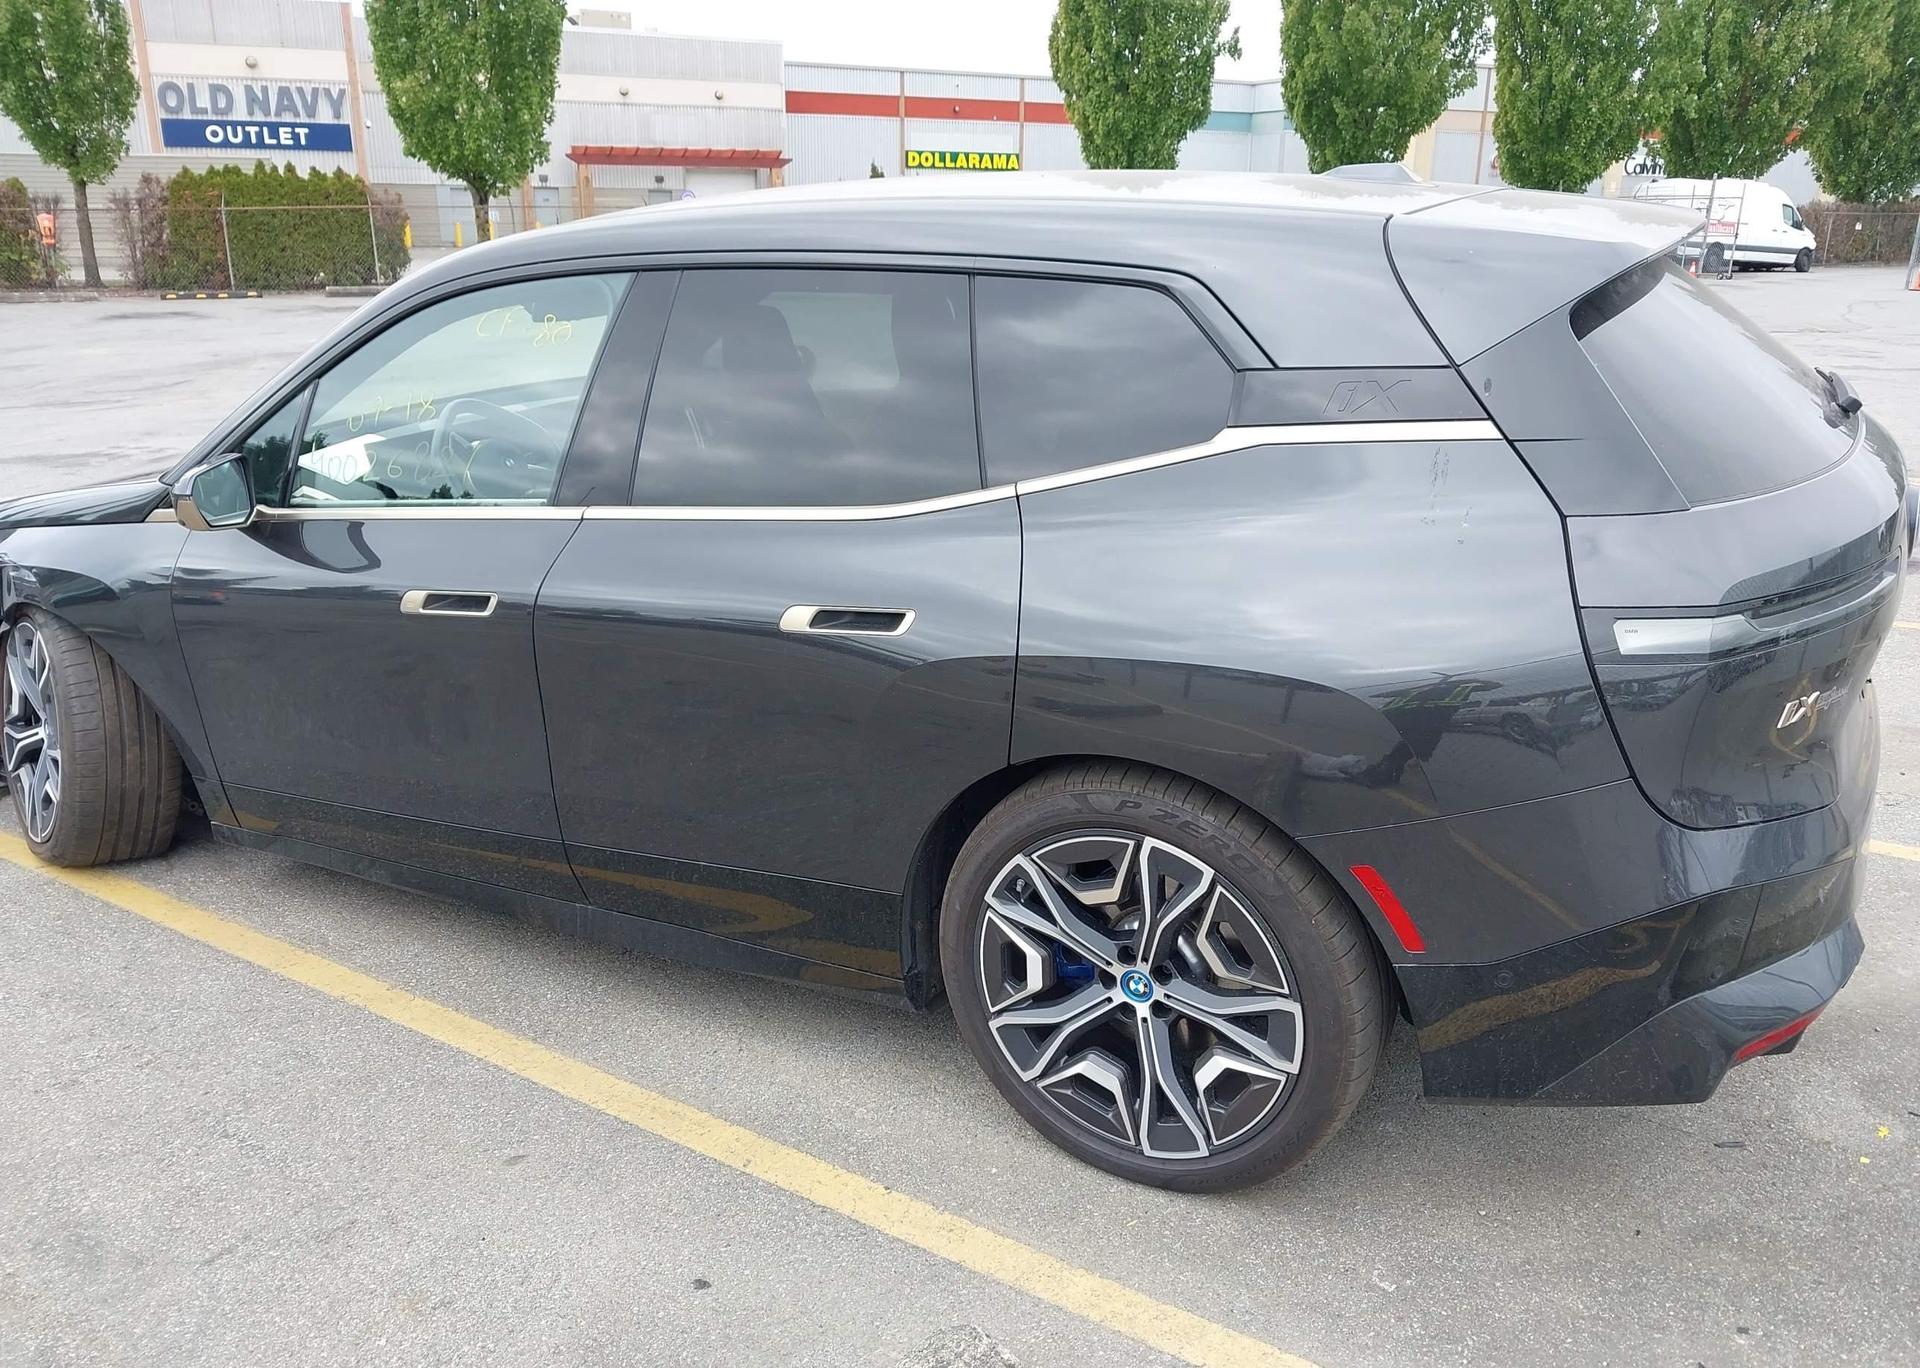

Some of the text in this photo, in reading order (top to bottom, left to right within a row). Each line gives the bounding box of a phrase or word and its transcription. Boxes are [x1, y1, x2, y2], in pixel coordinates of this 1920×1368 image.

[157, 81, 347, 119] OLD NAVY
[205, 125, 309, 146] OUTLET
[907, 151, 1019, 170] DOLLARAMA
[1624, 157, 1663, 175] Calvin
[1114, 799, 1260, 874] P ZERO
